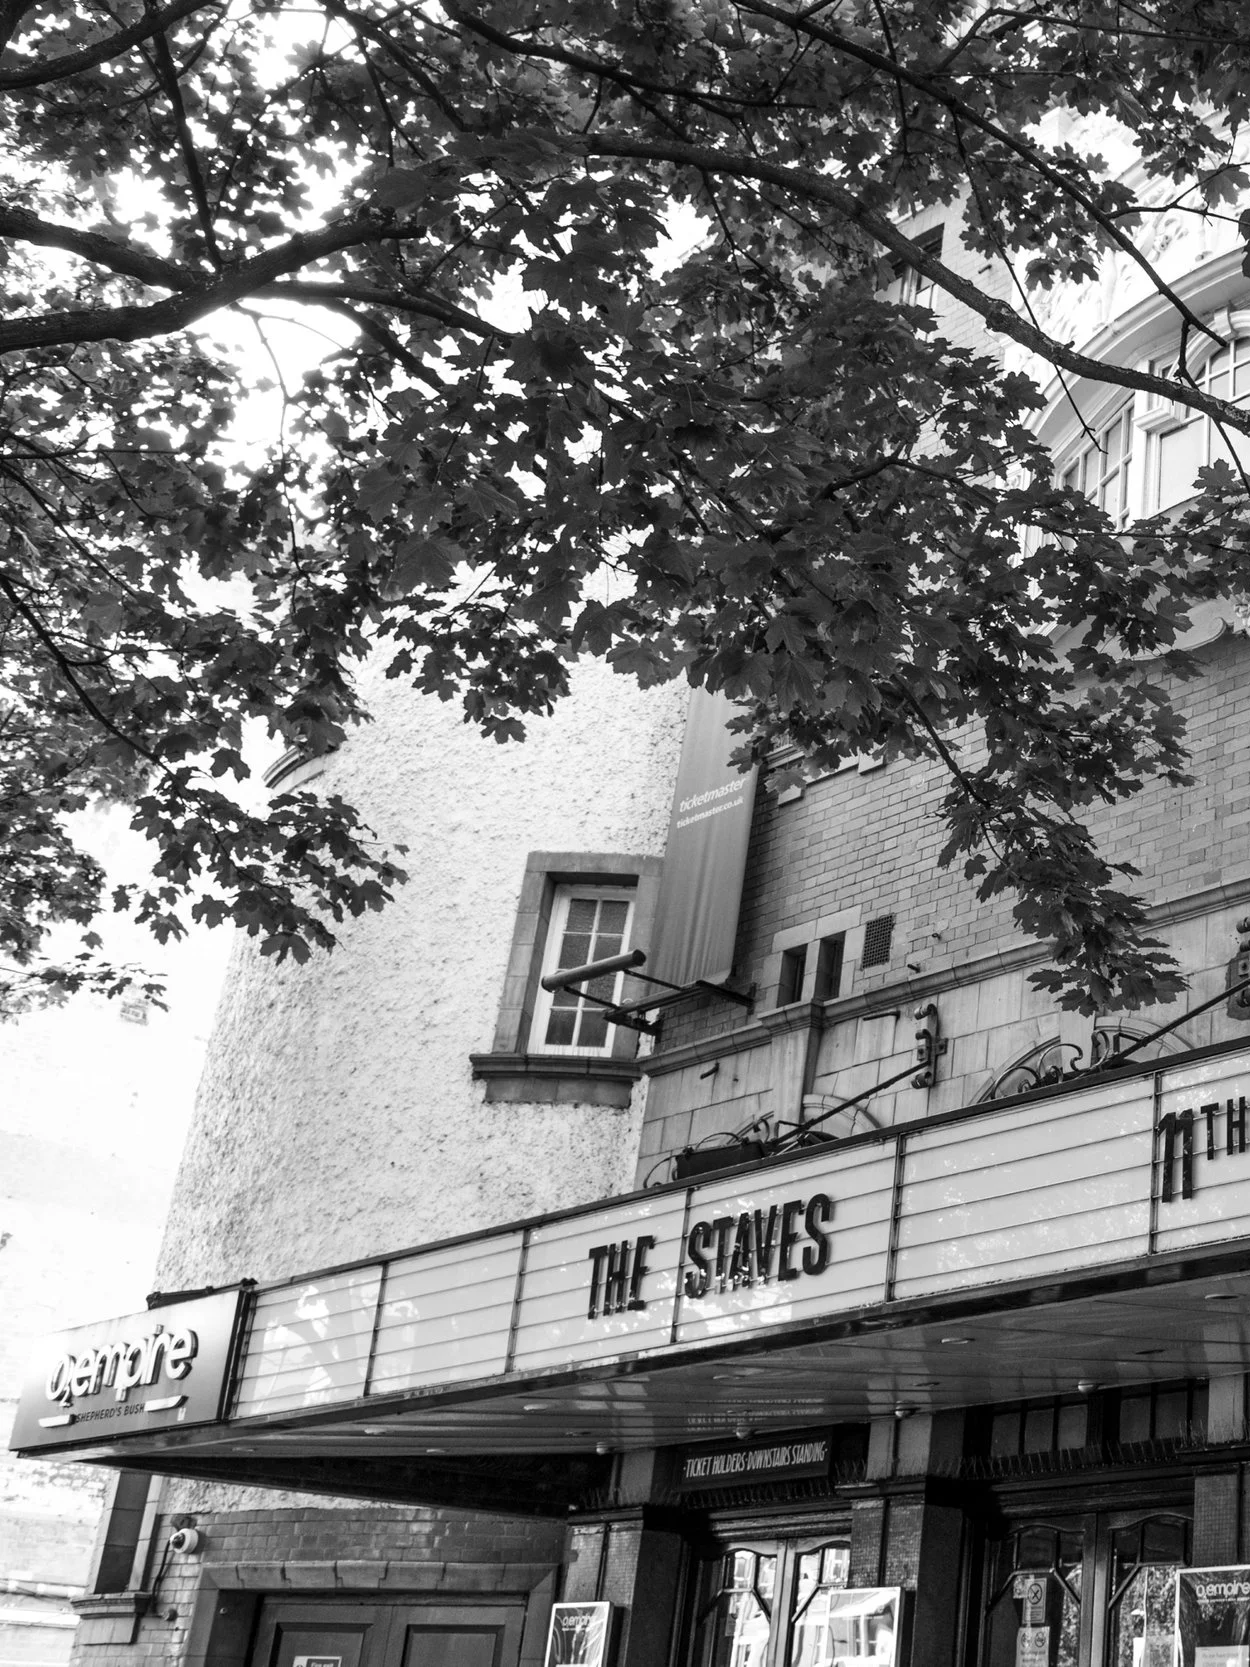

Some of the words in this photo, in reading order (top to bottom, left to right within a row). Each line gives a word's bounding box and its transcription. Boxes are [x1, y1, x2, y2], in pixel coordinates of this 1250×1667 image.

[676, 795, 744, 829] ticketmaster.co.uk
[679, 777, 747, 813] ticketmaster
[588, 1235, 655, 1320] THE
[684, 1193, 832, 1299] STAVES
[76, 1406, 123, 1424] SHEPHERD'S
[123, 1403, 145, 1417] BUSH
[686, 1456, 713, 1478] TICKET
[711, 1451, 746, 1475] HOLDERS
[747, 1445, 792, 1471] DOWNSTAIRS
[791, 1441, 826, 1465] STANDING
